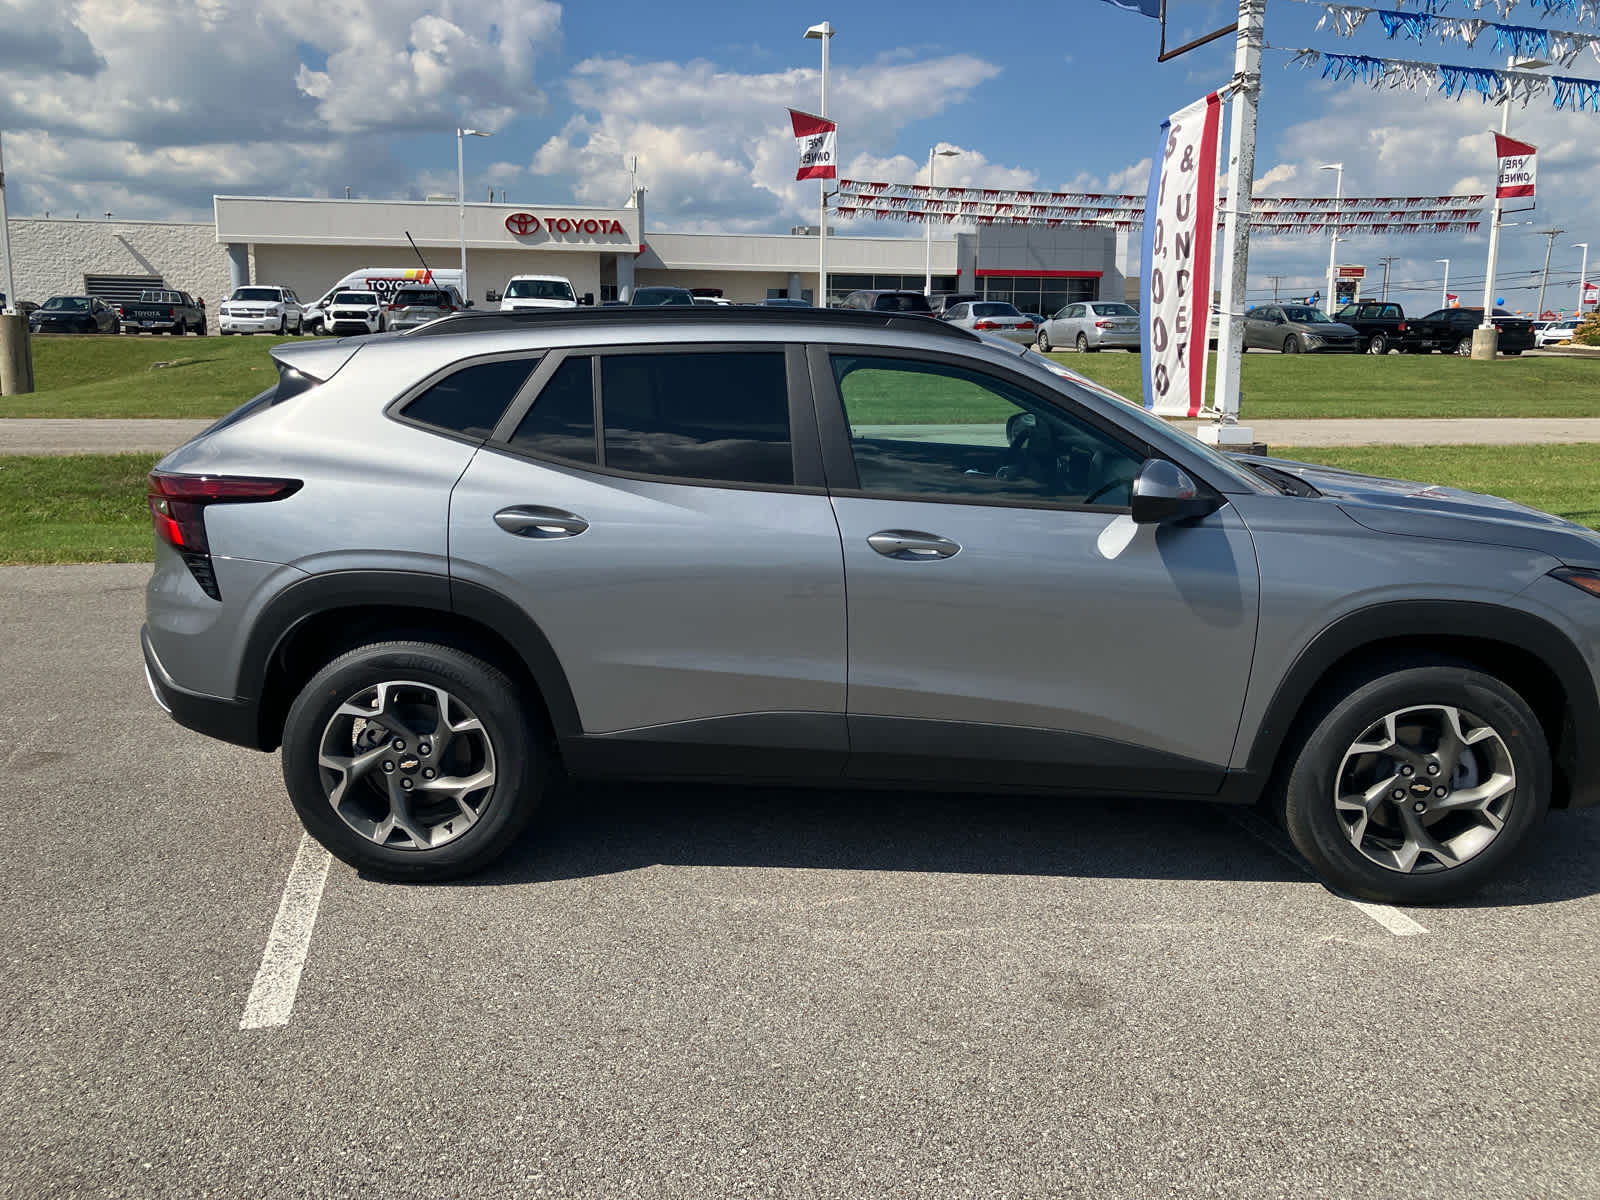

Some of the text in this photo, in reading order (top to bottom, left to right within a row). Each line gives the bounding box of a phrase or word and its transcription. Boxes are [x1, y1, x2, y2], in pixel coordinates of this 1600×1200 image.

[1180, 144, 1194, 173] &
[544, 217, 624, 235] TOYOTA
[367, 280, 421, 291] TOYO
[133, 310, 161, 318] TOYOTA
